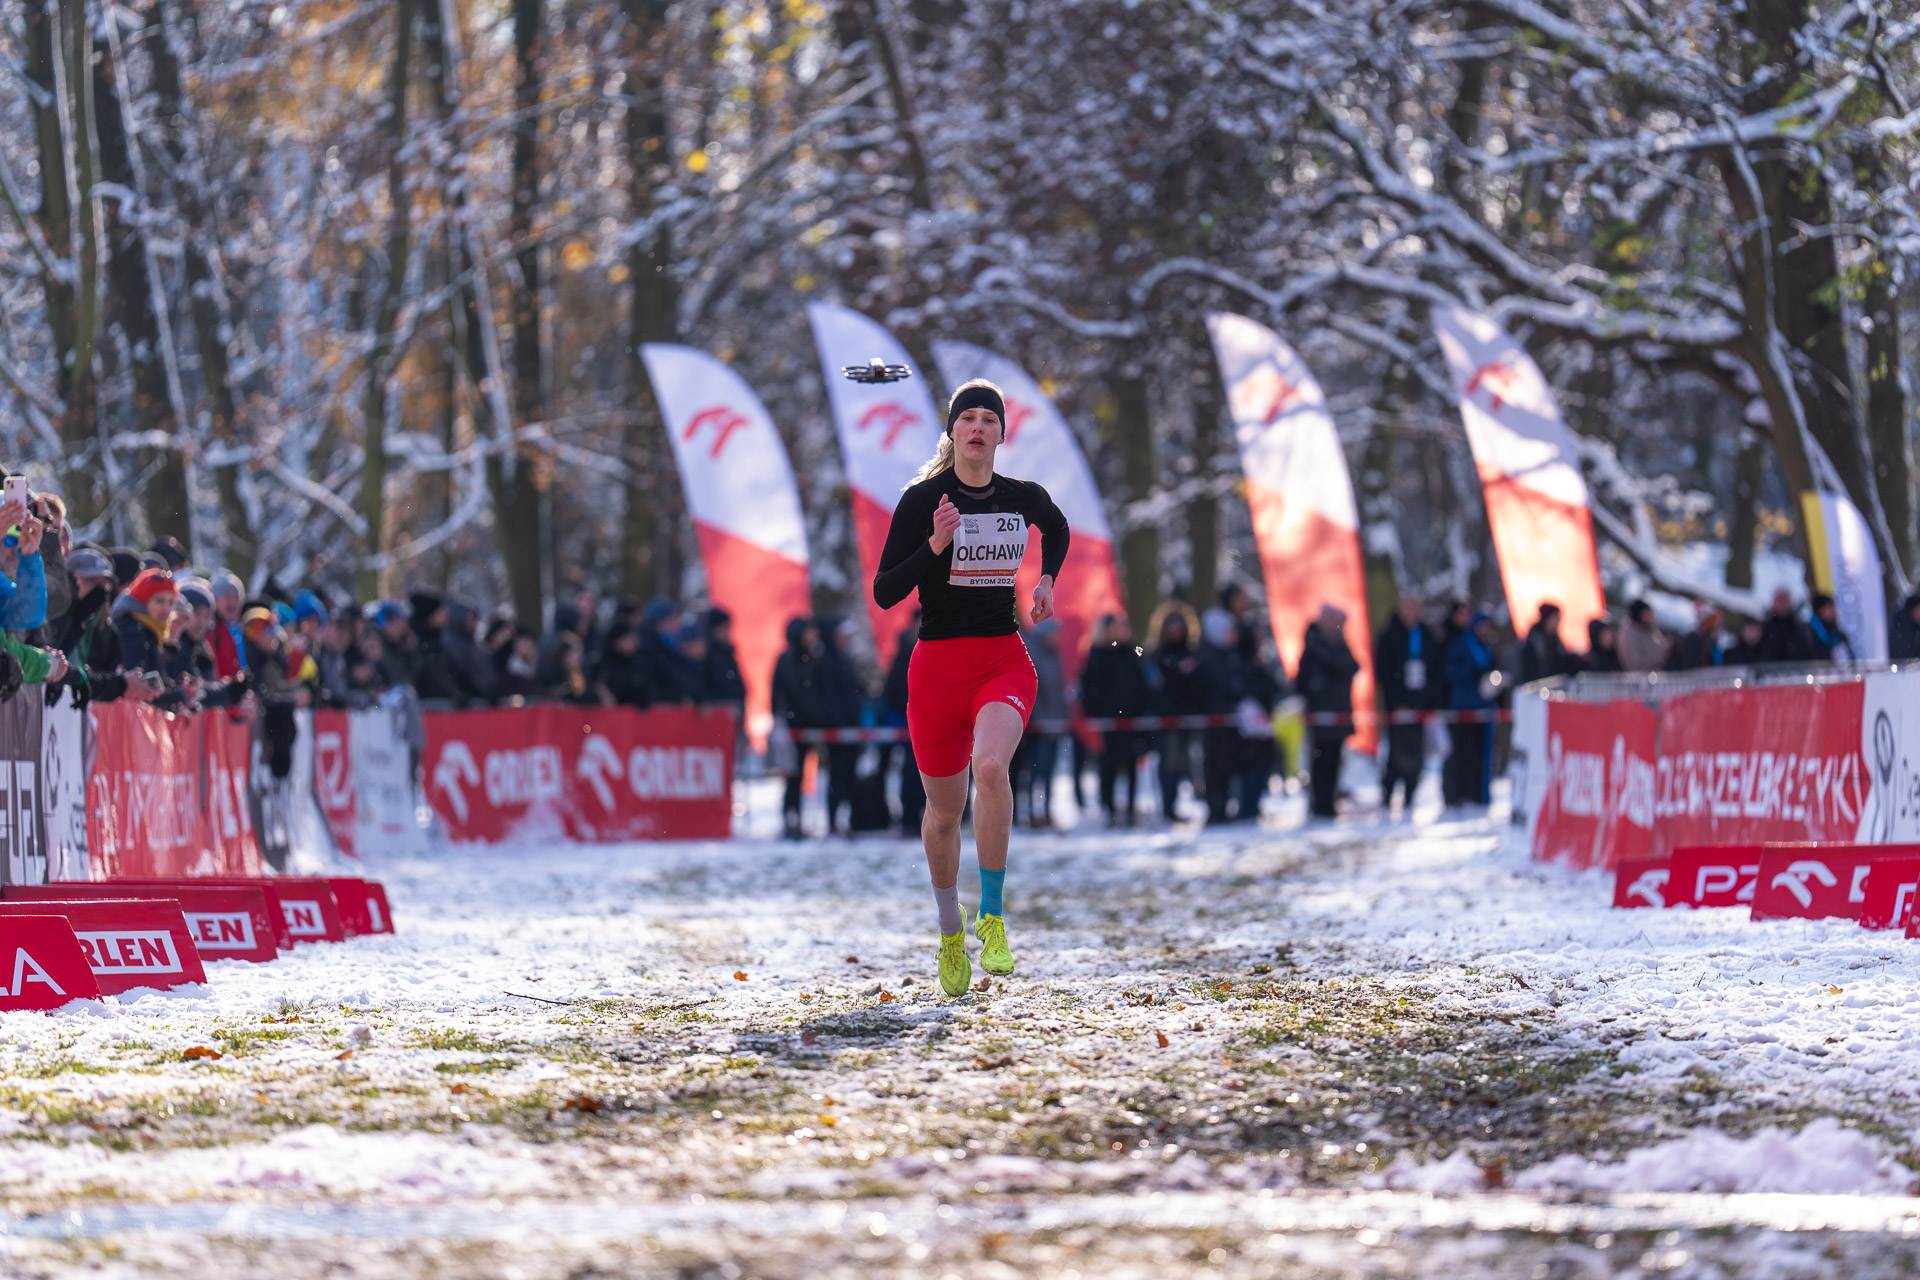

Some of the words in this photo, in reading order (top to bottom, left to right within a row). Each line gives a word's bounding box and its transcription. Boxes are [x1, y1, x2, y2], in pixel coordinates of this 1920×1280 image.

[996, 517, 1020, 532] 267
[956, 543, 1024, 562] OLCHAWA
[627, 745, 725, 799] ORLEN
[194, 918, 246, 943] EN
